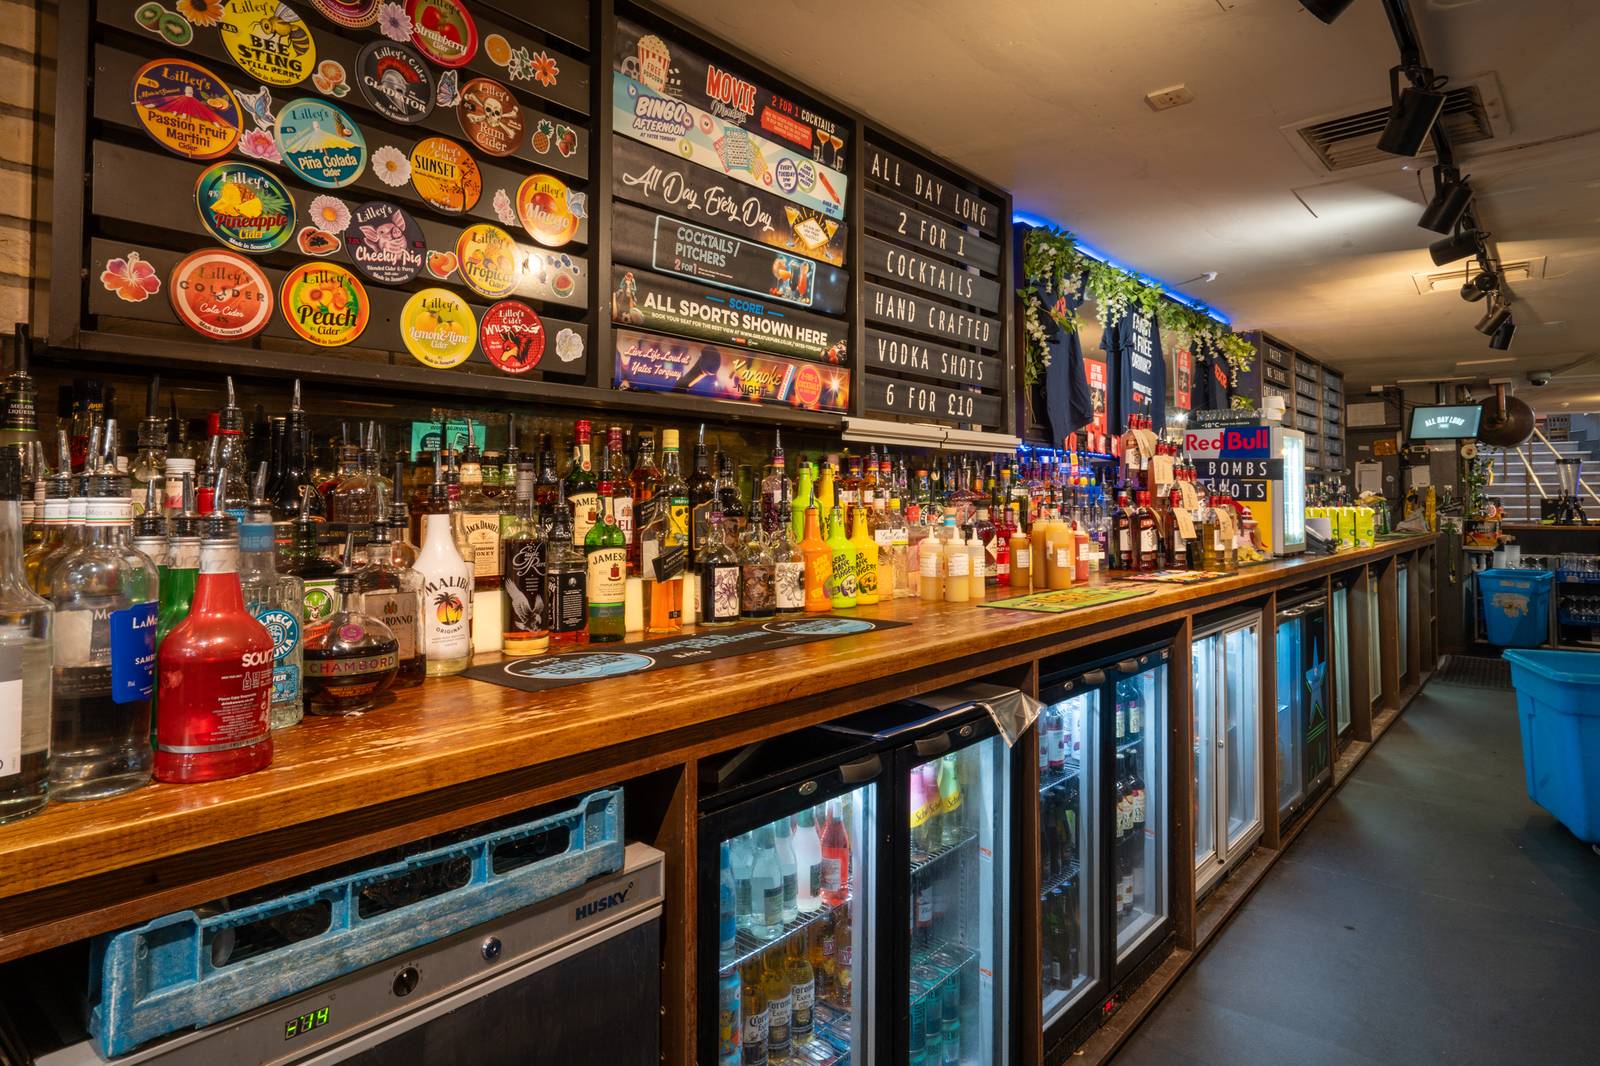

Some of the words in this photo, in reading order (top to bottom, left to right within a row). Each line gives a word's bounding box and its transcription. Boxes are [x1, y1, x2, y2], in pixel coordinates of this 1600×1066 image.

[250, 34, 290, 56] BEE
[414, 23, 468, 56] Strawberry
[238, 44, 303, 72] STING
[374, 46, 407, 60] Lilley's
[408, 58, 427, 84] Cider
[162, 66, 211, 91] Lilley's
[240, 58, 269, 71] STILL
[271, 66, 301, 79] PERRY
[647, 62, 662, 76] FREE
[480, 82, 510, 101] Lilley's
[706, 64, 757, 116] MOVIE
[291, 108, 330, 121] Lilley's
[635, 94, 687, 123] BINGO
[771, 95, 777, 106] 2
[779, 98, 793, 115] FOR
[795, 105, 800, 117] 1
[801, 109, 836, 134] COCKTAILS
[148, 110, 195, 132] Passion
[199, 123, 227, 140] Fruit
[480, 121, 505, 140] Rum
[633, 117, 687, 137] AFTERNOON
[166, 127, 210, 147] Martini
[178, 141, 198, 151] Cider
[476, 131, 507, 152] Cider
[298, 155, 322, 170] Piña
[323, 153, 358, 168] Colada
[414, 154, 456, 178] SUNSET
[221, 171, 270, 190] Lilley's
[533, 183, 564, 198] Lilley's
[871, 152, 901, 187] ALL
[915, 173, 943, 205] DAY
[954, 193, 987, 227] LONG
[622, 165, 663, 198] All
[662, 171, 702, 210] Day
[704, 185, 742, 222] Every
[742, 197, 775, 233] Day
[214, 212, 289, 231] Pineapple
[356, 204, 393, 223] Lilley's
[525, 202, 570, 228] Mango
[238, 229, 263, 240] Cider
[897, 212, 907, 235] 2
[920, 220, 947, 250] FOR
[957, 235, 965, 256] 1
[355, 246, 397, 265] Cheeky
[401, 248, 422, 267] Pig
[675, 242, 727, 268] PITCHERS
[198, 266, 251, 286] Lilley's
[674, 258, 681, 271] 2
[681, 262, 693, 273] FOR
[693, 262, 698, 275] 1
[886, 250, 973, 298] COCKTAILS
[302, 270, 353, 288] Lilley's
[200, 302, 221, 314] Cola
[222, 306, 244, 317] Cider
[422, 298, 460, 312] Lilley's
[499, 309, 525, 319] Lilley's
[729, 298, 764, 316] SCORE!
[297, 304, 357, 327] Peach
[502, 316, 521, 325] Cider
[643, 292, 676, 314] ALL
[679, 300, 740, 327] SPORTS
[742, 314, 794, 339] SHOWN
[796, 326, 829, 347] HERE
[666, 315, 680, 323] YOUR
[692, 320, 701, 328] FOR
[702, 322, 711, 330] THE
[723, 326, 734, 334] VIEW
[875, 292, 916, 323] HAND
[928, 307, 990, 342] CRAFTED
[317, 325, 341, 336] Cider
[485, 324, 512, 336] WILD
[513, 323, 541, 334] DOG
[431, 340, 448, 350] Cider
[878, 338, 929, 370] VODKA
[941, 352, 984, 381] SHOTS
[631, 361, 652, 375] Yates
[654, 364, 682, 381] Torquay
[731, 359, 782, 386] Karaoke
[886, 383, 895, 406] 6
[908, 387, 936, 413] FOR
[947, 393, 974, 418] £10
[1185, 431, 1225, 451] Red
[1227, 429, 1268, 451] Bull
[1208, 461, 1267, 476] BOMBS
[466, 521, 481, 534] JACK
[260, 613, 293, 630] LMECA
[435, 624, 463, 635] ORIGINAL
[309, 656, 395, 674] CHAMBORD
[576, 889, 629, 921] HUSKY
